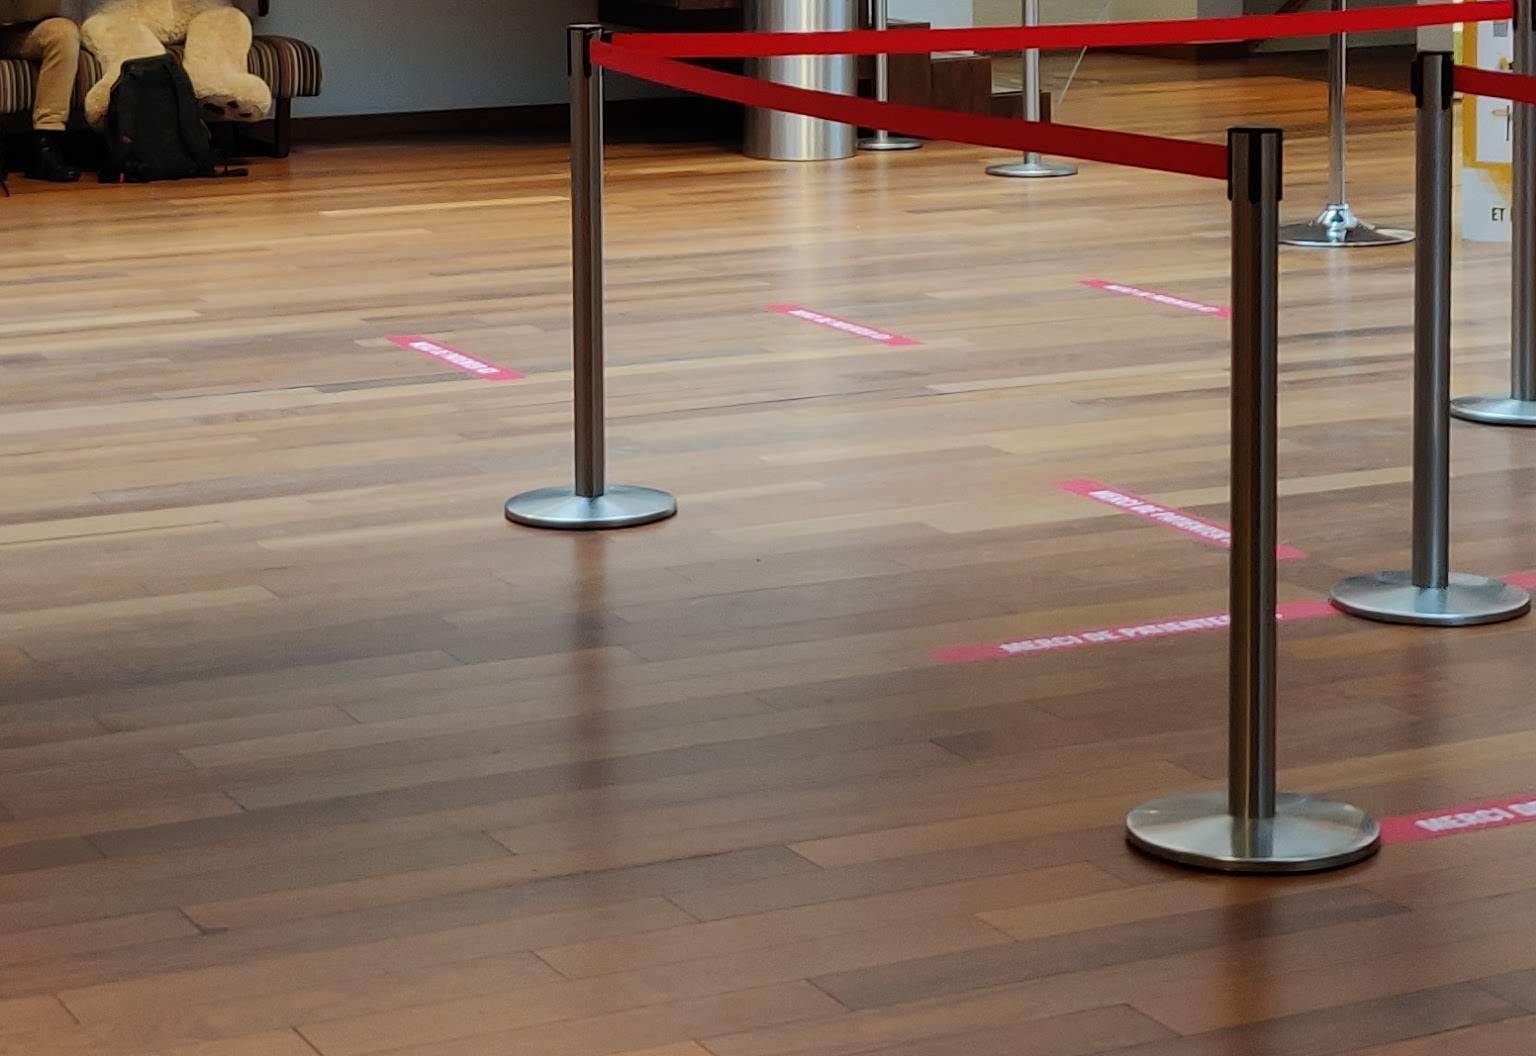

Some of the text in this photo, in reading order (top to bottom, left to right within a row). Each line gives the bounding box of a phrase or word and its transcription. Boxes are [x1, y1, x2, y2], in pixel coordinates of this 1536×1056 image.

[1491, 207, 1505, 222] ET
[999, 635, 1083, 653] MERCI
[1081, 630, 1123, 642] DE
[1415, 807, 1515, 832] MERCI
